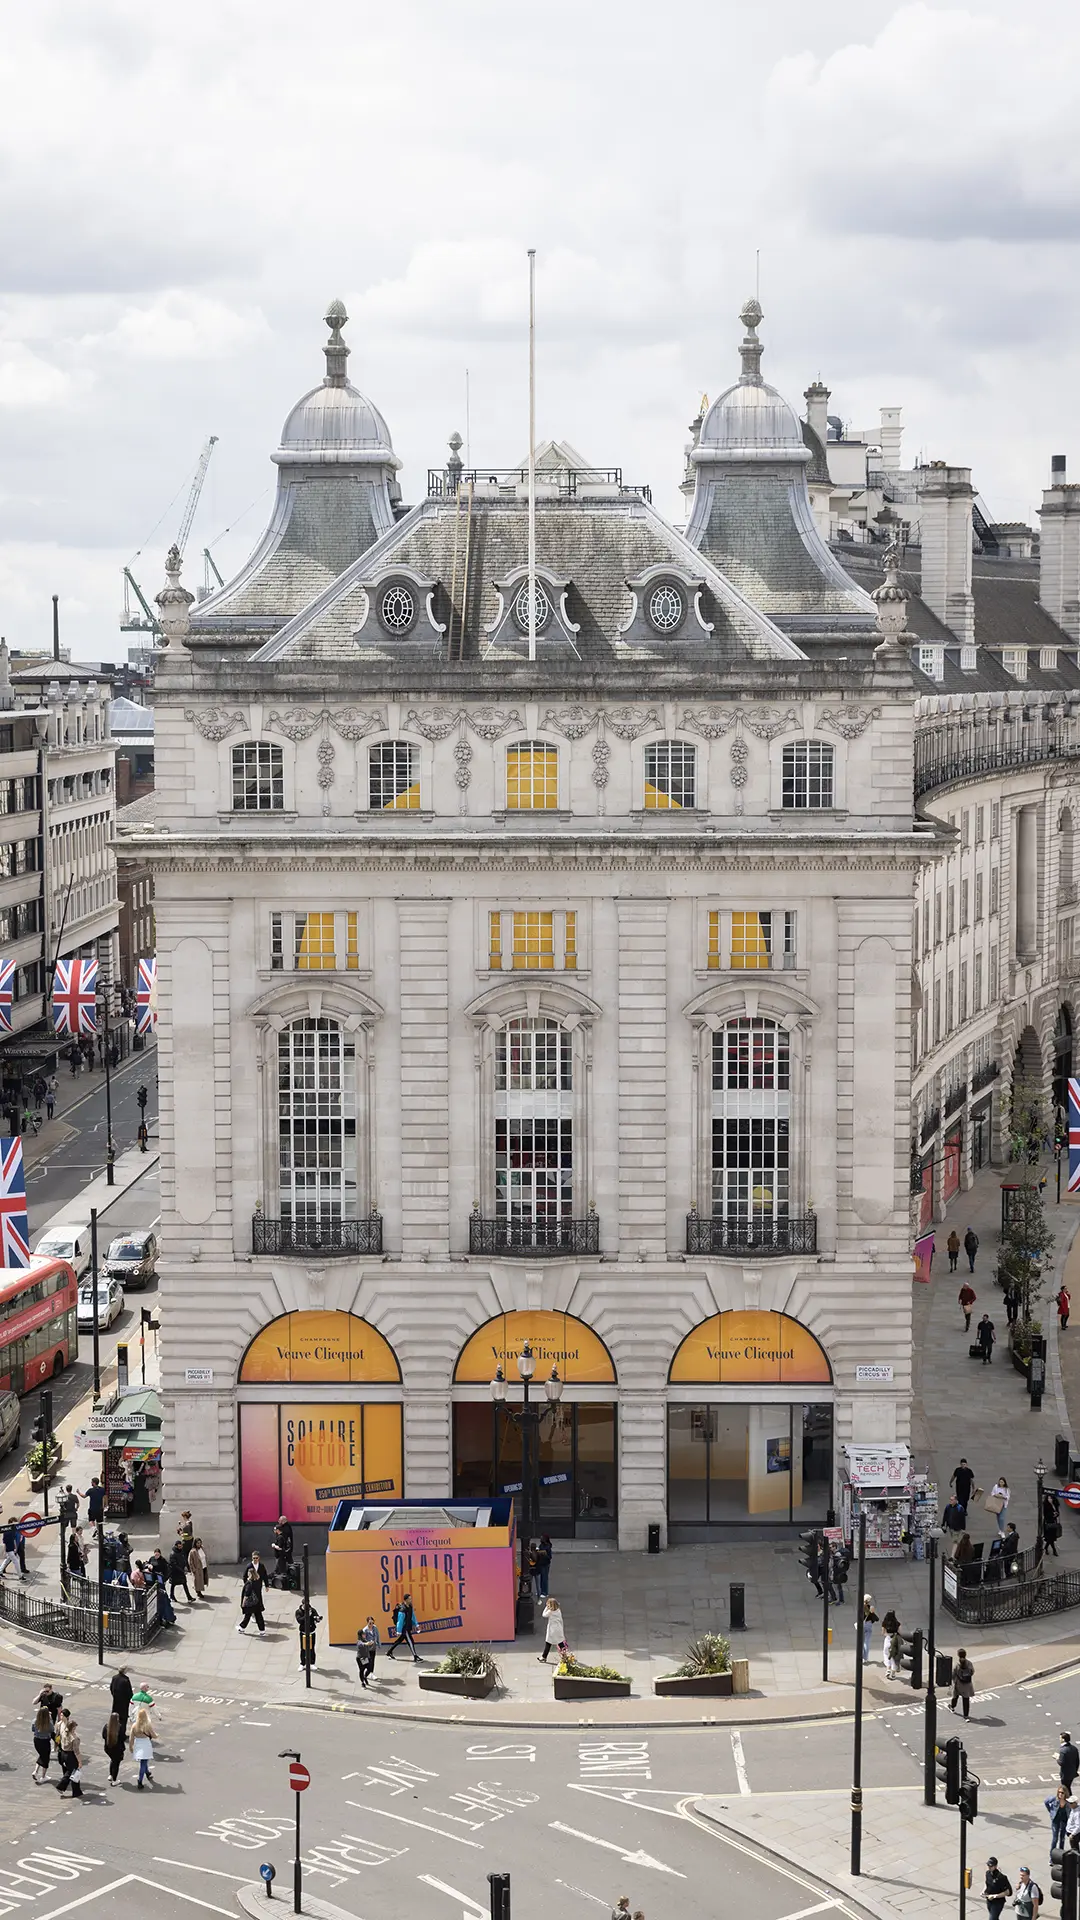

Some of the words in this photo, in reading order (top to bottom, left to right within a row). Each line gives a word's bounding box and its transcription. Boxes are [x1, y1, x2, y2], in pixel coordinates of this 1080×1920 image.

[276, 1346, 311, 1360] Veuve
[314, 1346, 365, 1362] Clicquot
[491, 1346, 524, 1360] Veuv
[706, 1346, 741, 1360] Veuve
[744, 1346, 795, 1362] Clicquot
[287, 1420, 355, 1443] SOLAIRE
[287, 1443, 355, 1467] CULTURE
[16, 1520, 45, 1530] UNDERGROUND
[389, 1537, 414, 1547] Veuve
[416, 1536, 452, 1547] Clicquot
[380, 1553, 465, 1583] SOLAIRE
[198, 1695, 235, 1705] LOOK
[465, 1744, 537, 1762] ST
[579, 1741, 652, 1780] RGNT
[341, 1755, 440, 1796] AVE
[984, 1777, 1030, 1786] LOOK
[16, 1846, 105, 1880] NO
